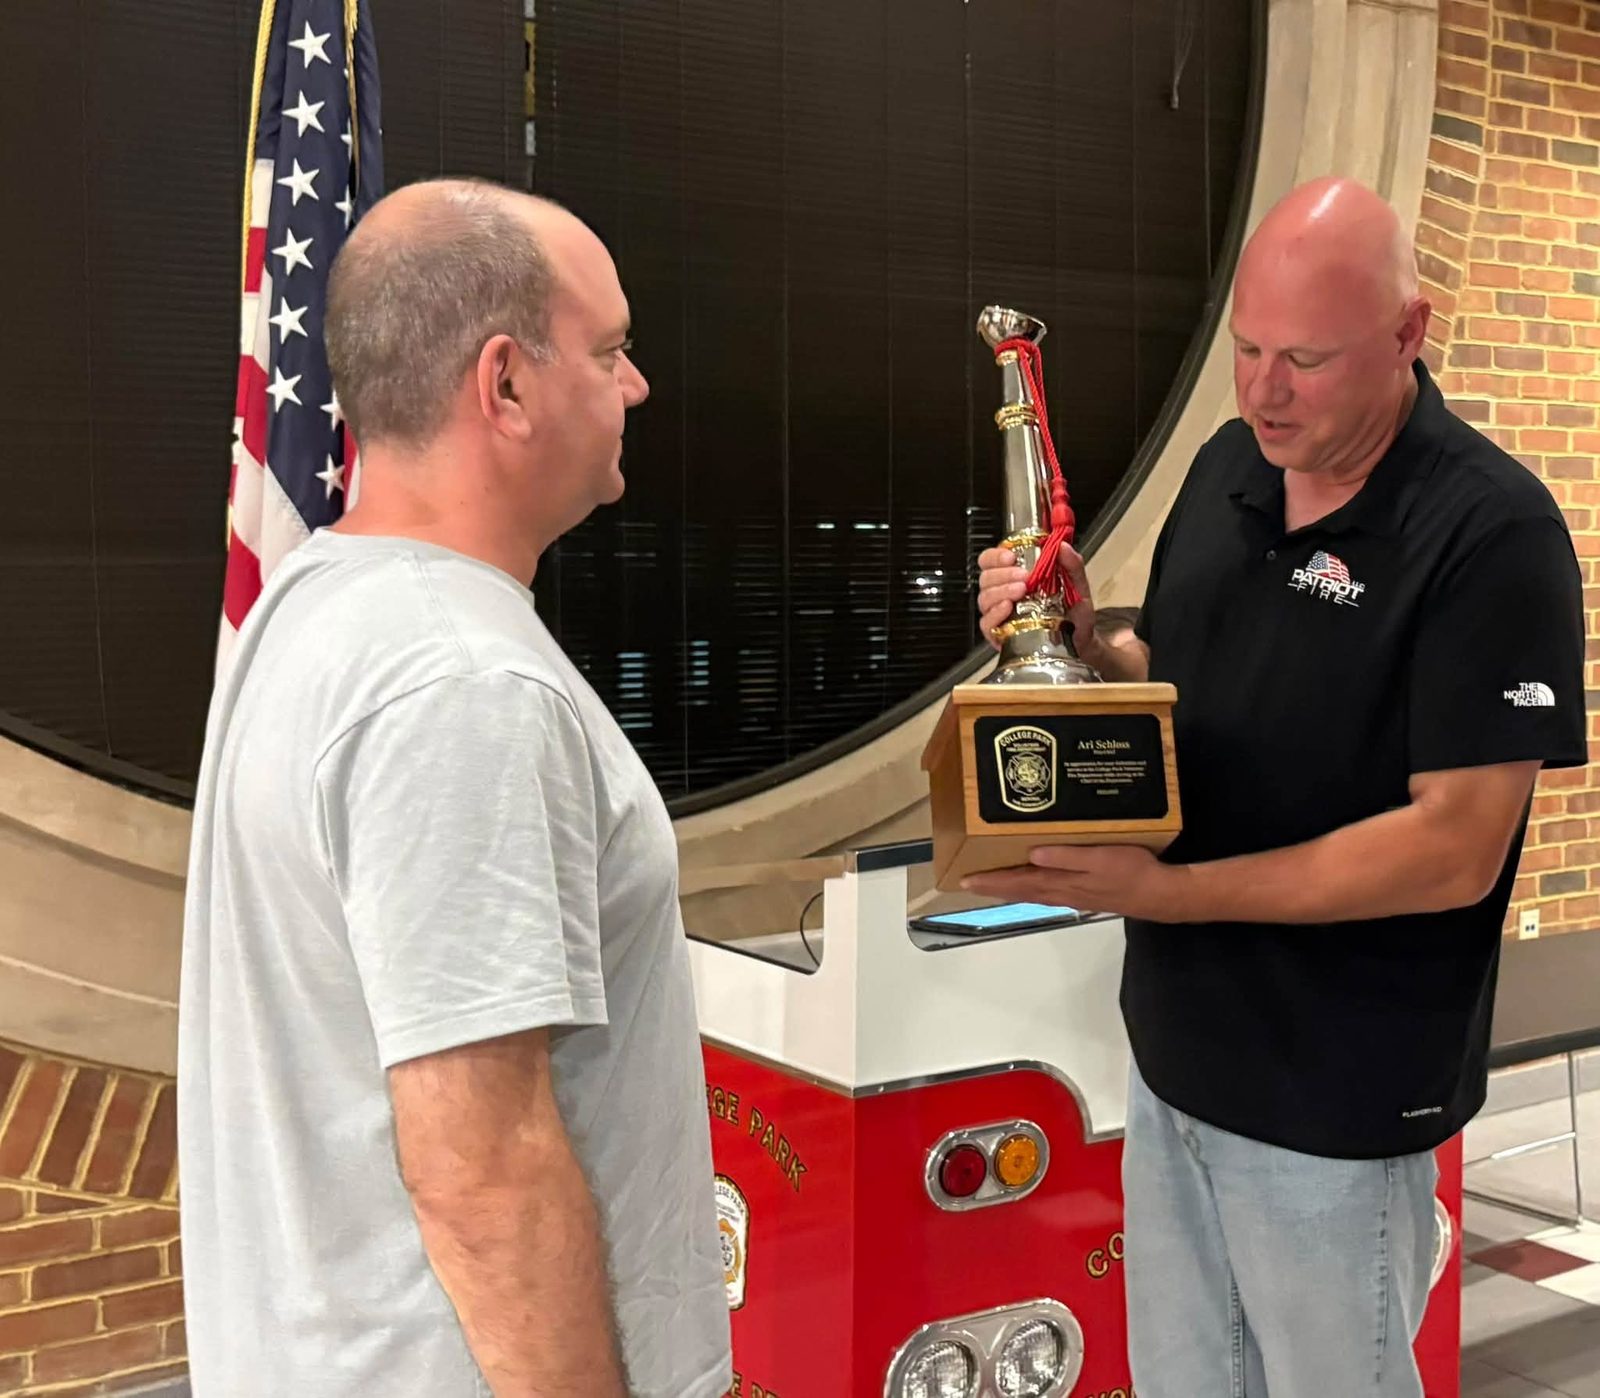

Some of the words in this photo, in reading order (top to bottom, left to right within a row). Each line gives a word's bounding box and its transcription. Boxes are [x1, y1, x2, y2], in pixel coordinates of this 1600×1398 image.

[1291, 568, 1364, 600] PATRIOT
[1518, 682, 1538, 691] THE
[1503, 690, 1538, 700] NORTH
[1513, 699, 1539, 707] FACE
[1000, 731, 1031, 747] COLLEGE
[1078, 740, 1094, 750] Ari
[706, 1084, 740, 1126] GE
[749, 1106, 808, 1192] PARK
